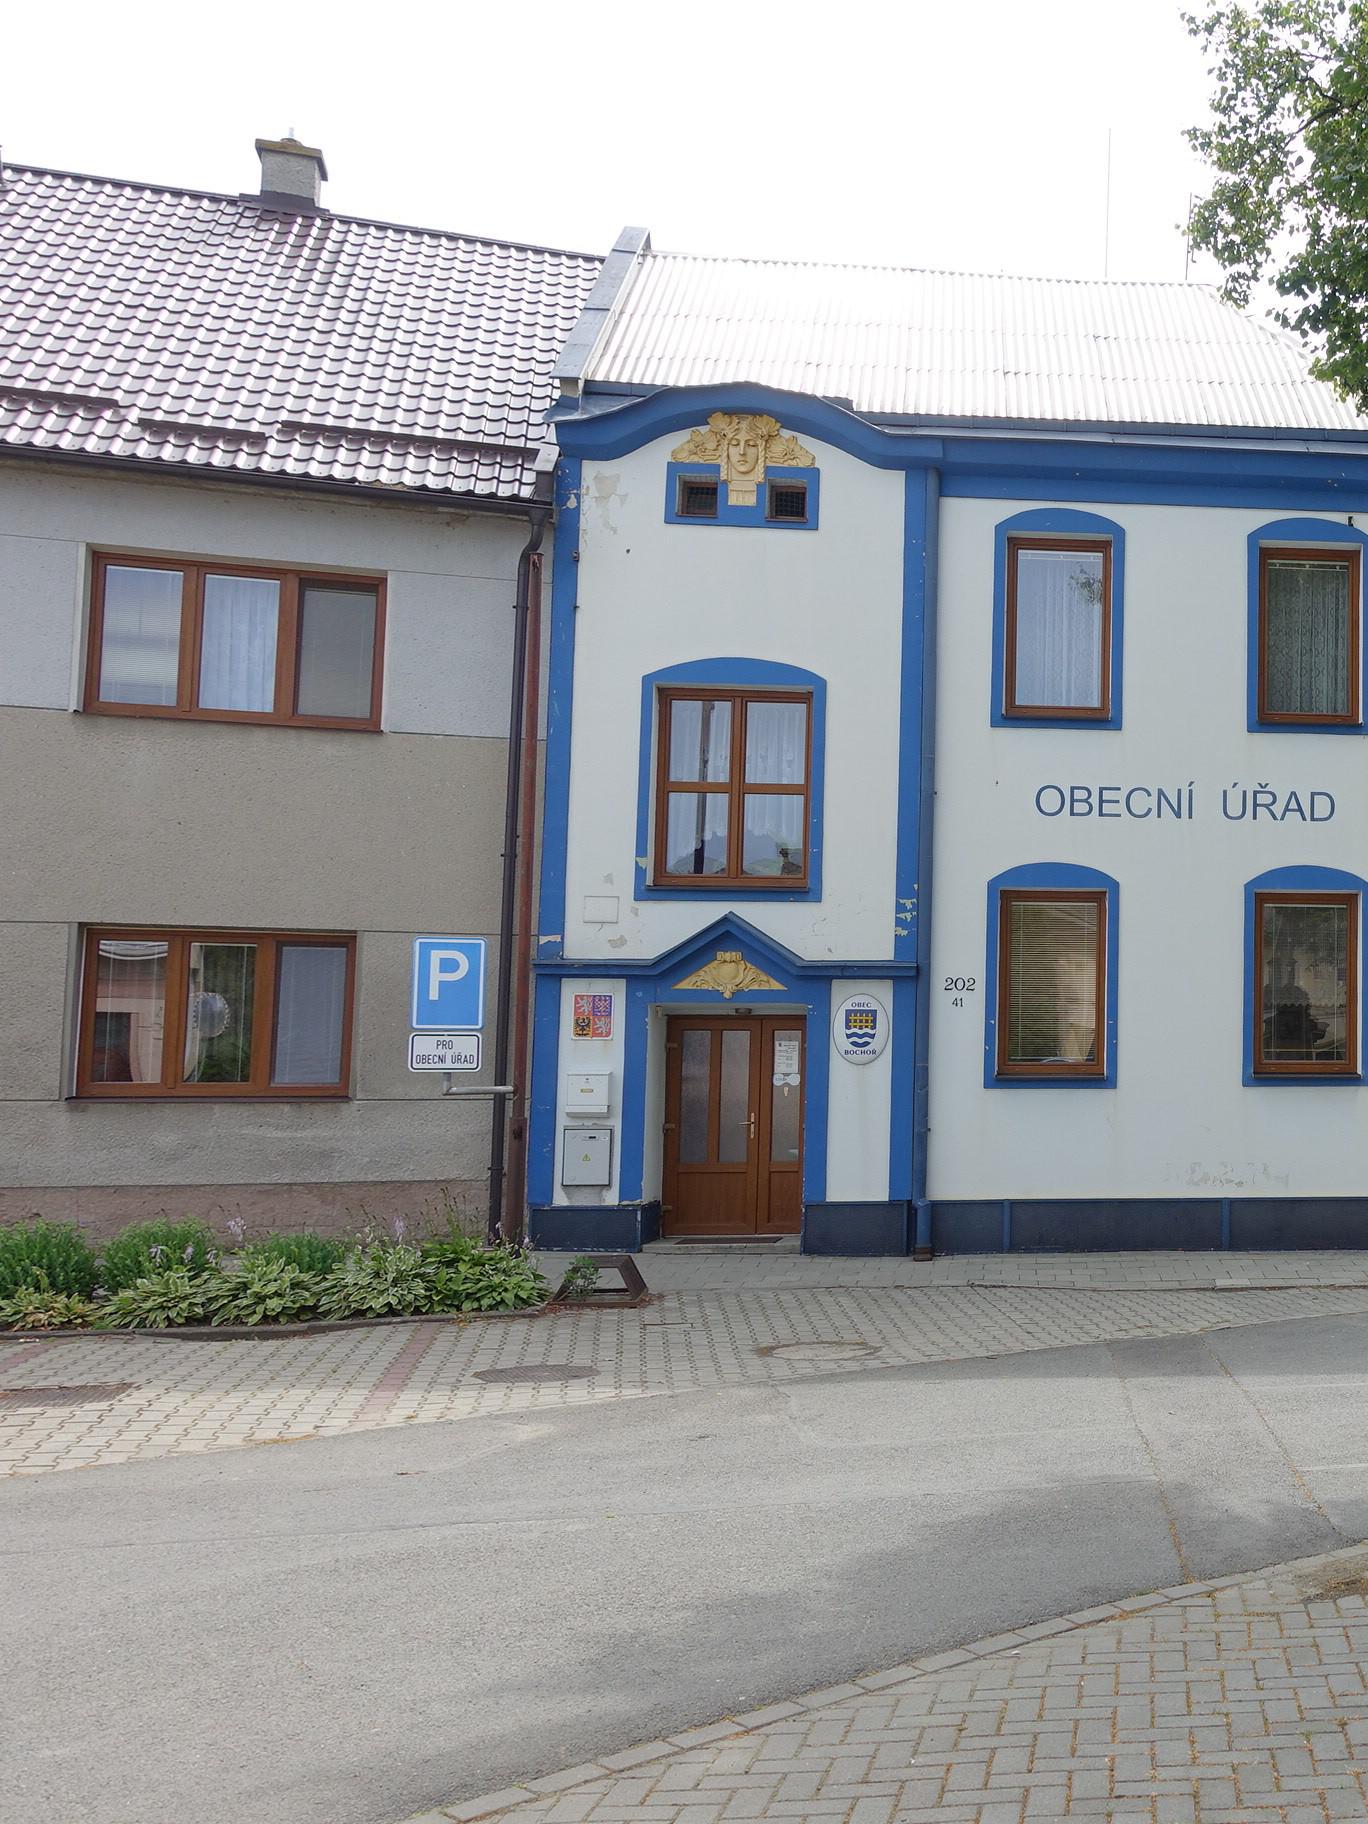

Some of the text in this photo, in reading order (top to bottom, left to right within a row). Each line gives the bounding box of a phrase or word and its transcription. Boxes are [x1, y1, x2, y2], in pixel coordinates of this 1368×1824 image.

[1035, 781, 1336, 822] OBECNÍ ÚŘAD
[429, 950, 469, 1001] P
[944, 977, 976, 991] 202
[952, 997, 964, 1007] 41
[436, 1040, 453, 1050] PRO
[415, 1052, 475, 1064] OBECNÍ ÚŘAD
[844, 1048, 877, 1056] BOCHOŘ
